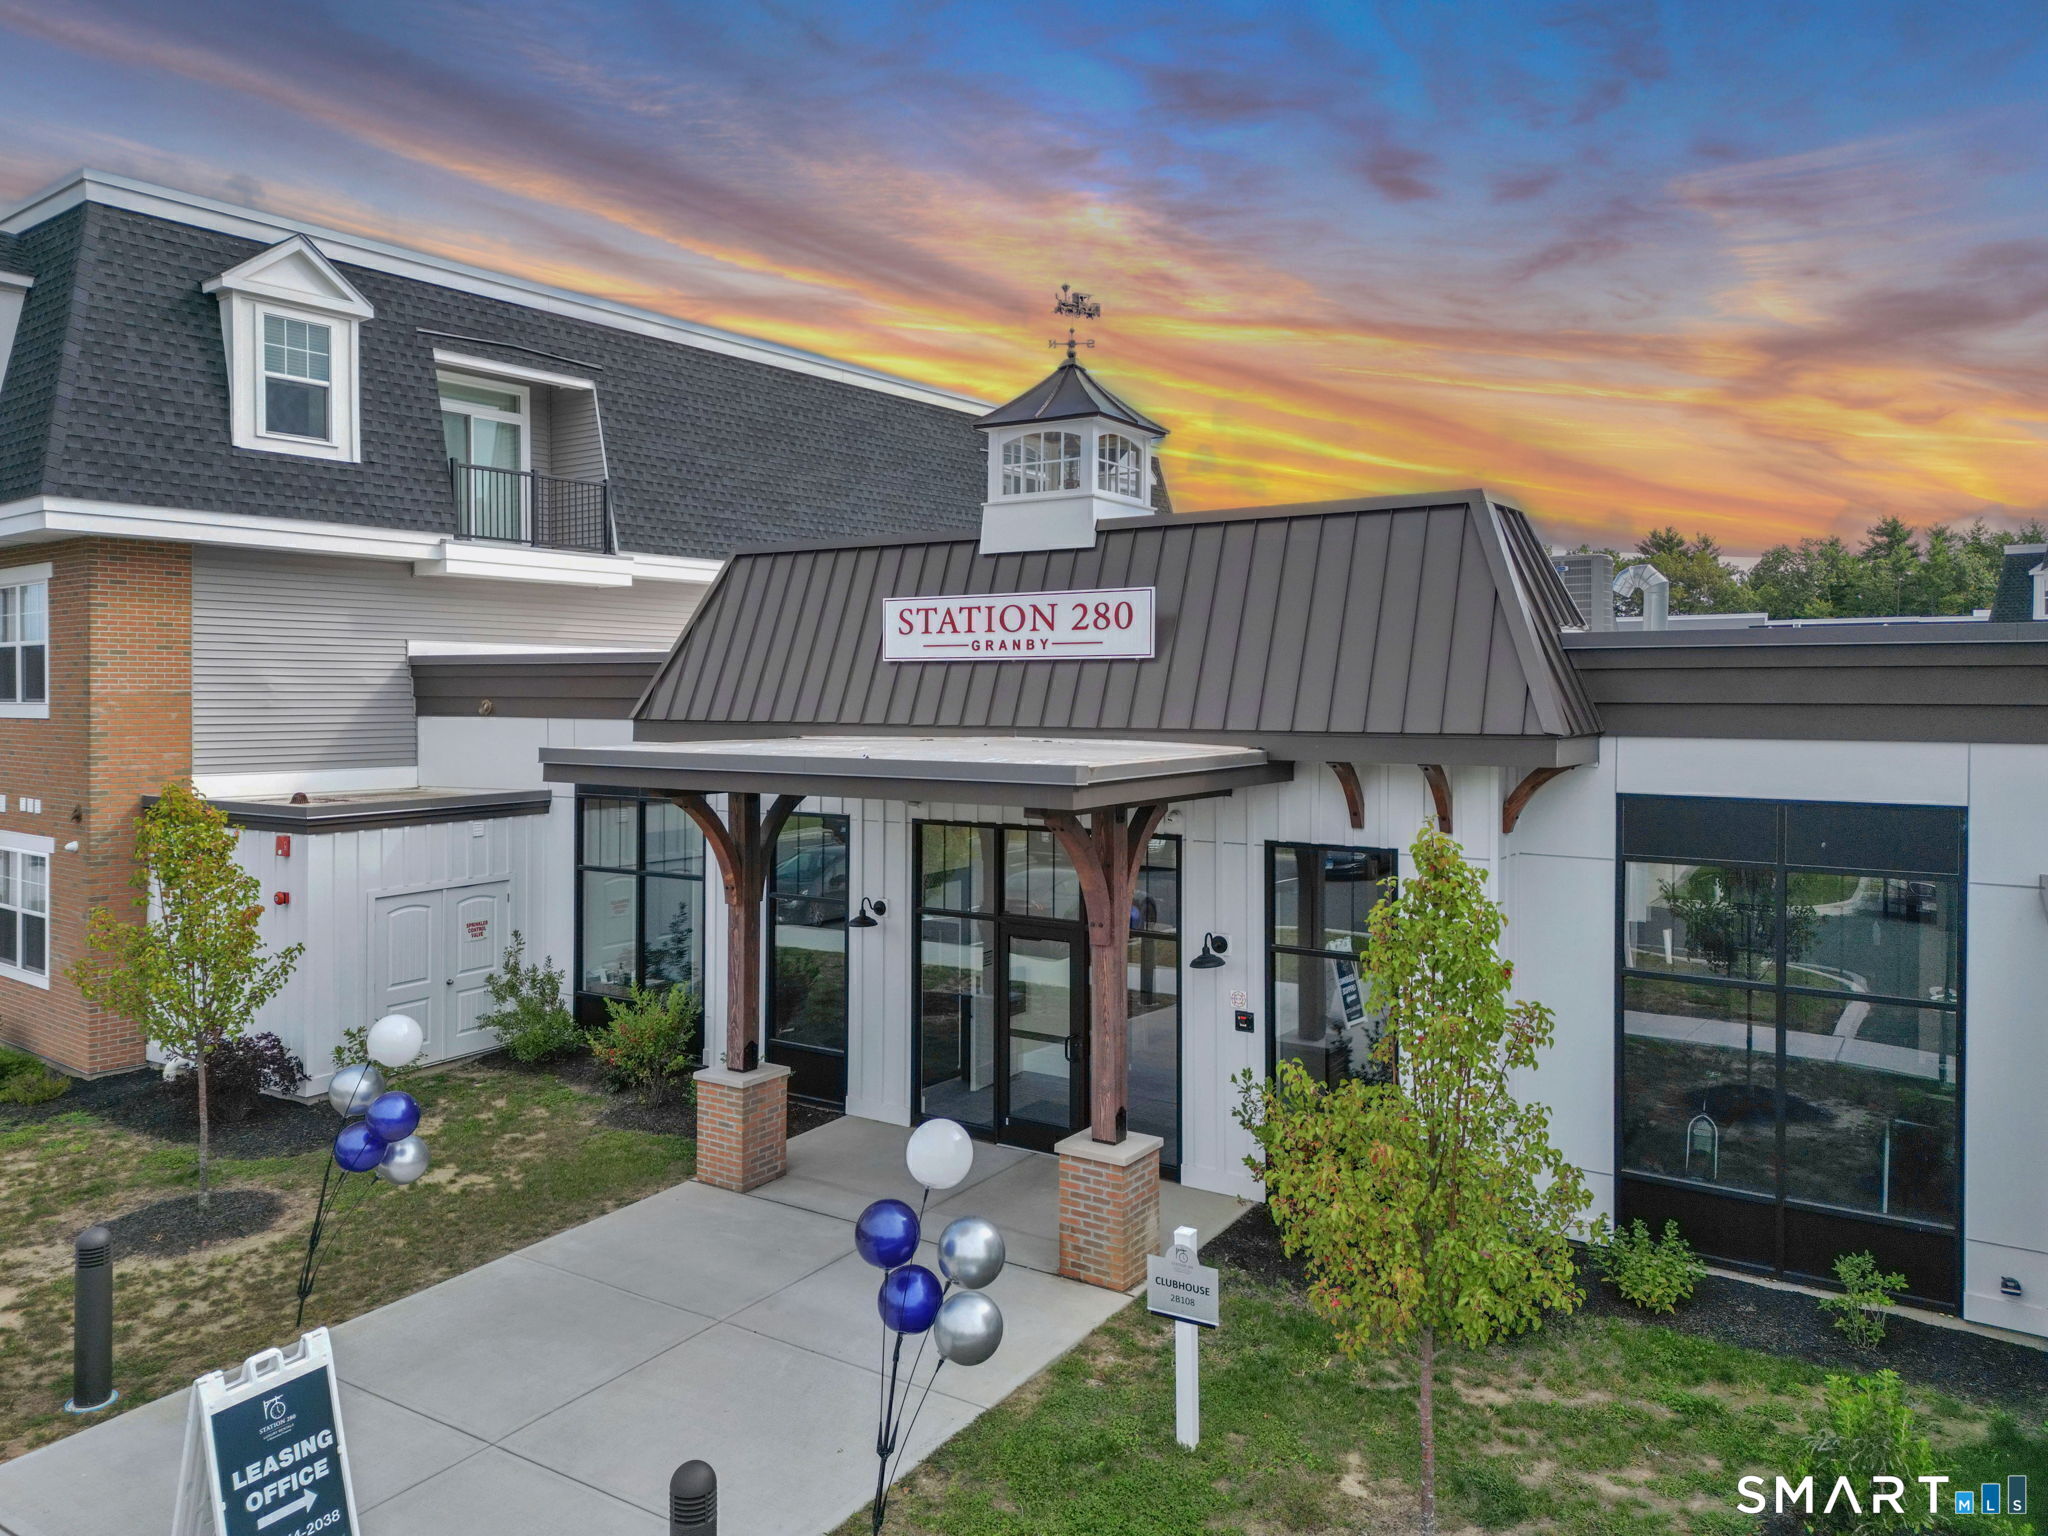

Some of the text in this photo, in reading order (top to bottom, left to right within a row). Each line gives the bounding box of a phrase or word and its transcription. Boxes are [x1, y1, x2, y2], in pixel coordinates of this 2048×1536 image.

[898, 601, 1134, 635] STATION 280
[971, 638, 1049, 651] GRANBY
[1155, 1276, 1210, 1296] CLUBHOUSE
[258, 1418, 286, 1435] STATION
[231, 1429, 333, 1491] LEASING
[245, 1457, 330, 1512] OFFICE
